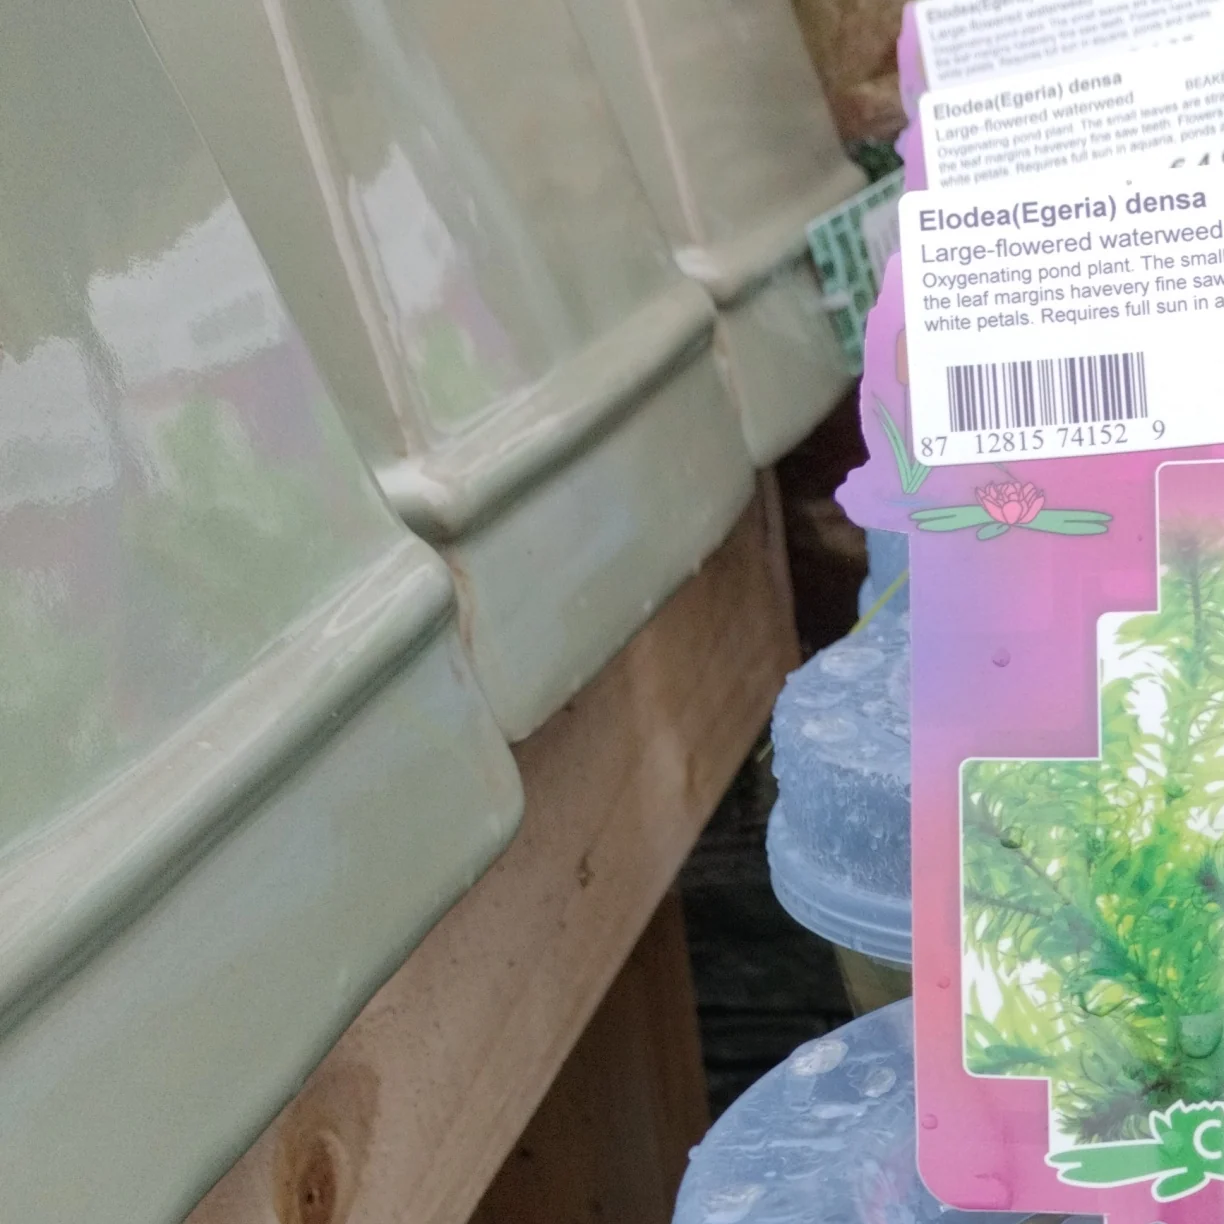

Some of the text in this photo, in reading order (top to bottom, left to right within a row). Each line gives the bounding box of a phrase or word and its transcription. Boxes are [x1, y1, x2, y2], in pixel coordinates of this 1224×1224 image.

[933, 72, 1122, 121] Elodea(Egeria) densa
[1052, 91, 1134, 120] waterweed
[938, 160, 957, 174] the
[985, 147, 1031, 166] margins
[1090, 131, 1112, 144] fine
[1115, 125, 1138, 139] saw
[1177, 109, 1224, 127] Flowers
[1013, 131, 1042, 148] pond
[1081, 117, 1102, 132] The
[1106, 110, 1137, 127] small
[1140, 102, 1178, 118] leaves
[1182, 97, 1200, 110] are
[1091, 146, 1113, 161] sun
[1116, 142, 1127, 155] in
[1180, 125, 1216, 144] ponds
[919, 190, 1207, 231] Elodea(Egeria) densa
[921, 219, 1224, 266] Large-flowered waterweed
[922, 266, 1033, 290] Oxygenating
[1038, 261, 1082, 283] pond
[1087, 258, 1134, 279] plant.
[1140, 254, 1175, 271] The
[923, 294, 951, 312] the
[956, 290, 989, 309] leaf
[994, 284, 1065, 307] margins
[1070, 279, 1149, 301] havevery
[1155, 275, 1188, 292] fine
[924, 315, 972, 333] white
[977, 310, 1035, 333] petals.
[1041, 304, 1120, 326] Requires
[1125, 299, 1151, 318] full
[1156, 298, 1188, 315] sun
[1193, 295, 1209, 310] in
[921, 419, 1166, 458] 87 12815 74152 9
[1193, 1119, 1223, 1160] C
